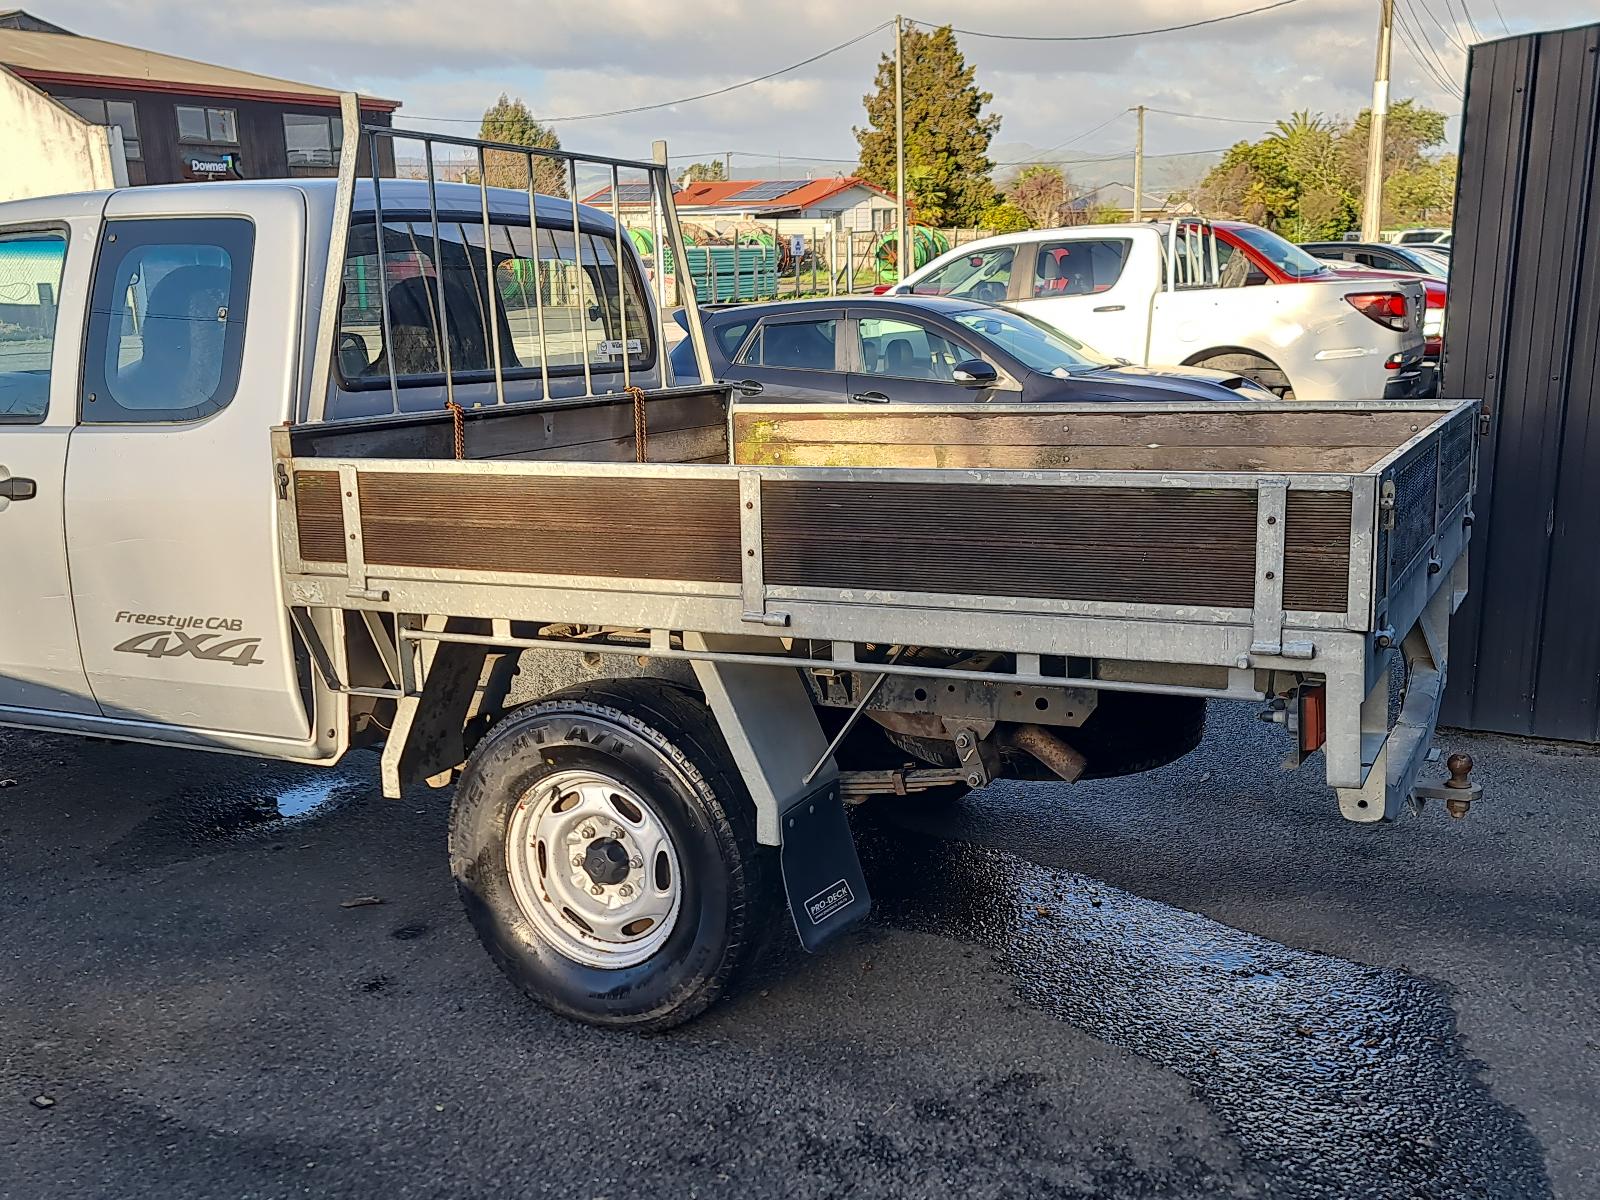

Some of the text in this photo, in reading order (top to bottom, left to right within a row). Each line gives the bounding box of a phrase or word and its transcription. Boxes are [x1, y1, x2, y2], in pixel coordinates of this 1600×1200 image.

[191, 159, 228, 171] Downer
[115, 611, 243, 631] Freestyle CAB
[810, 886, 848, 915] PRO-DECK
